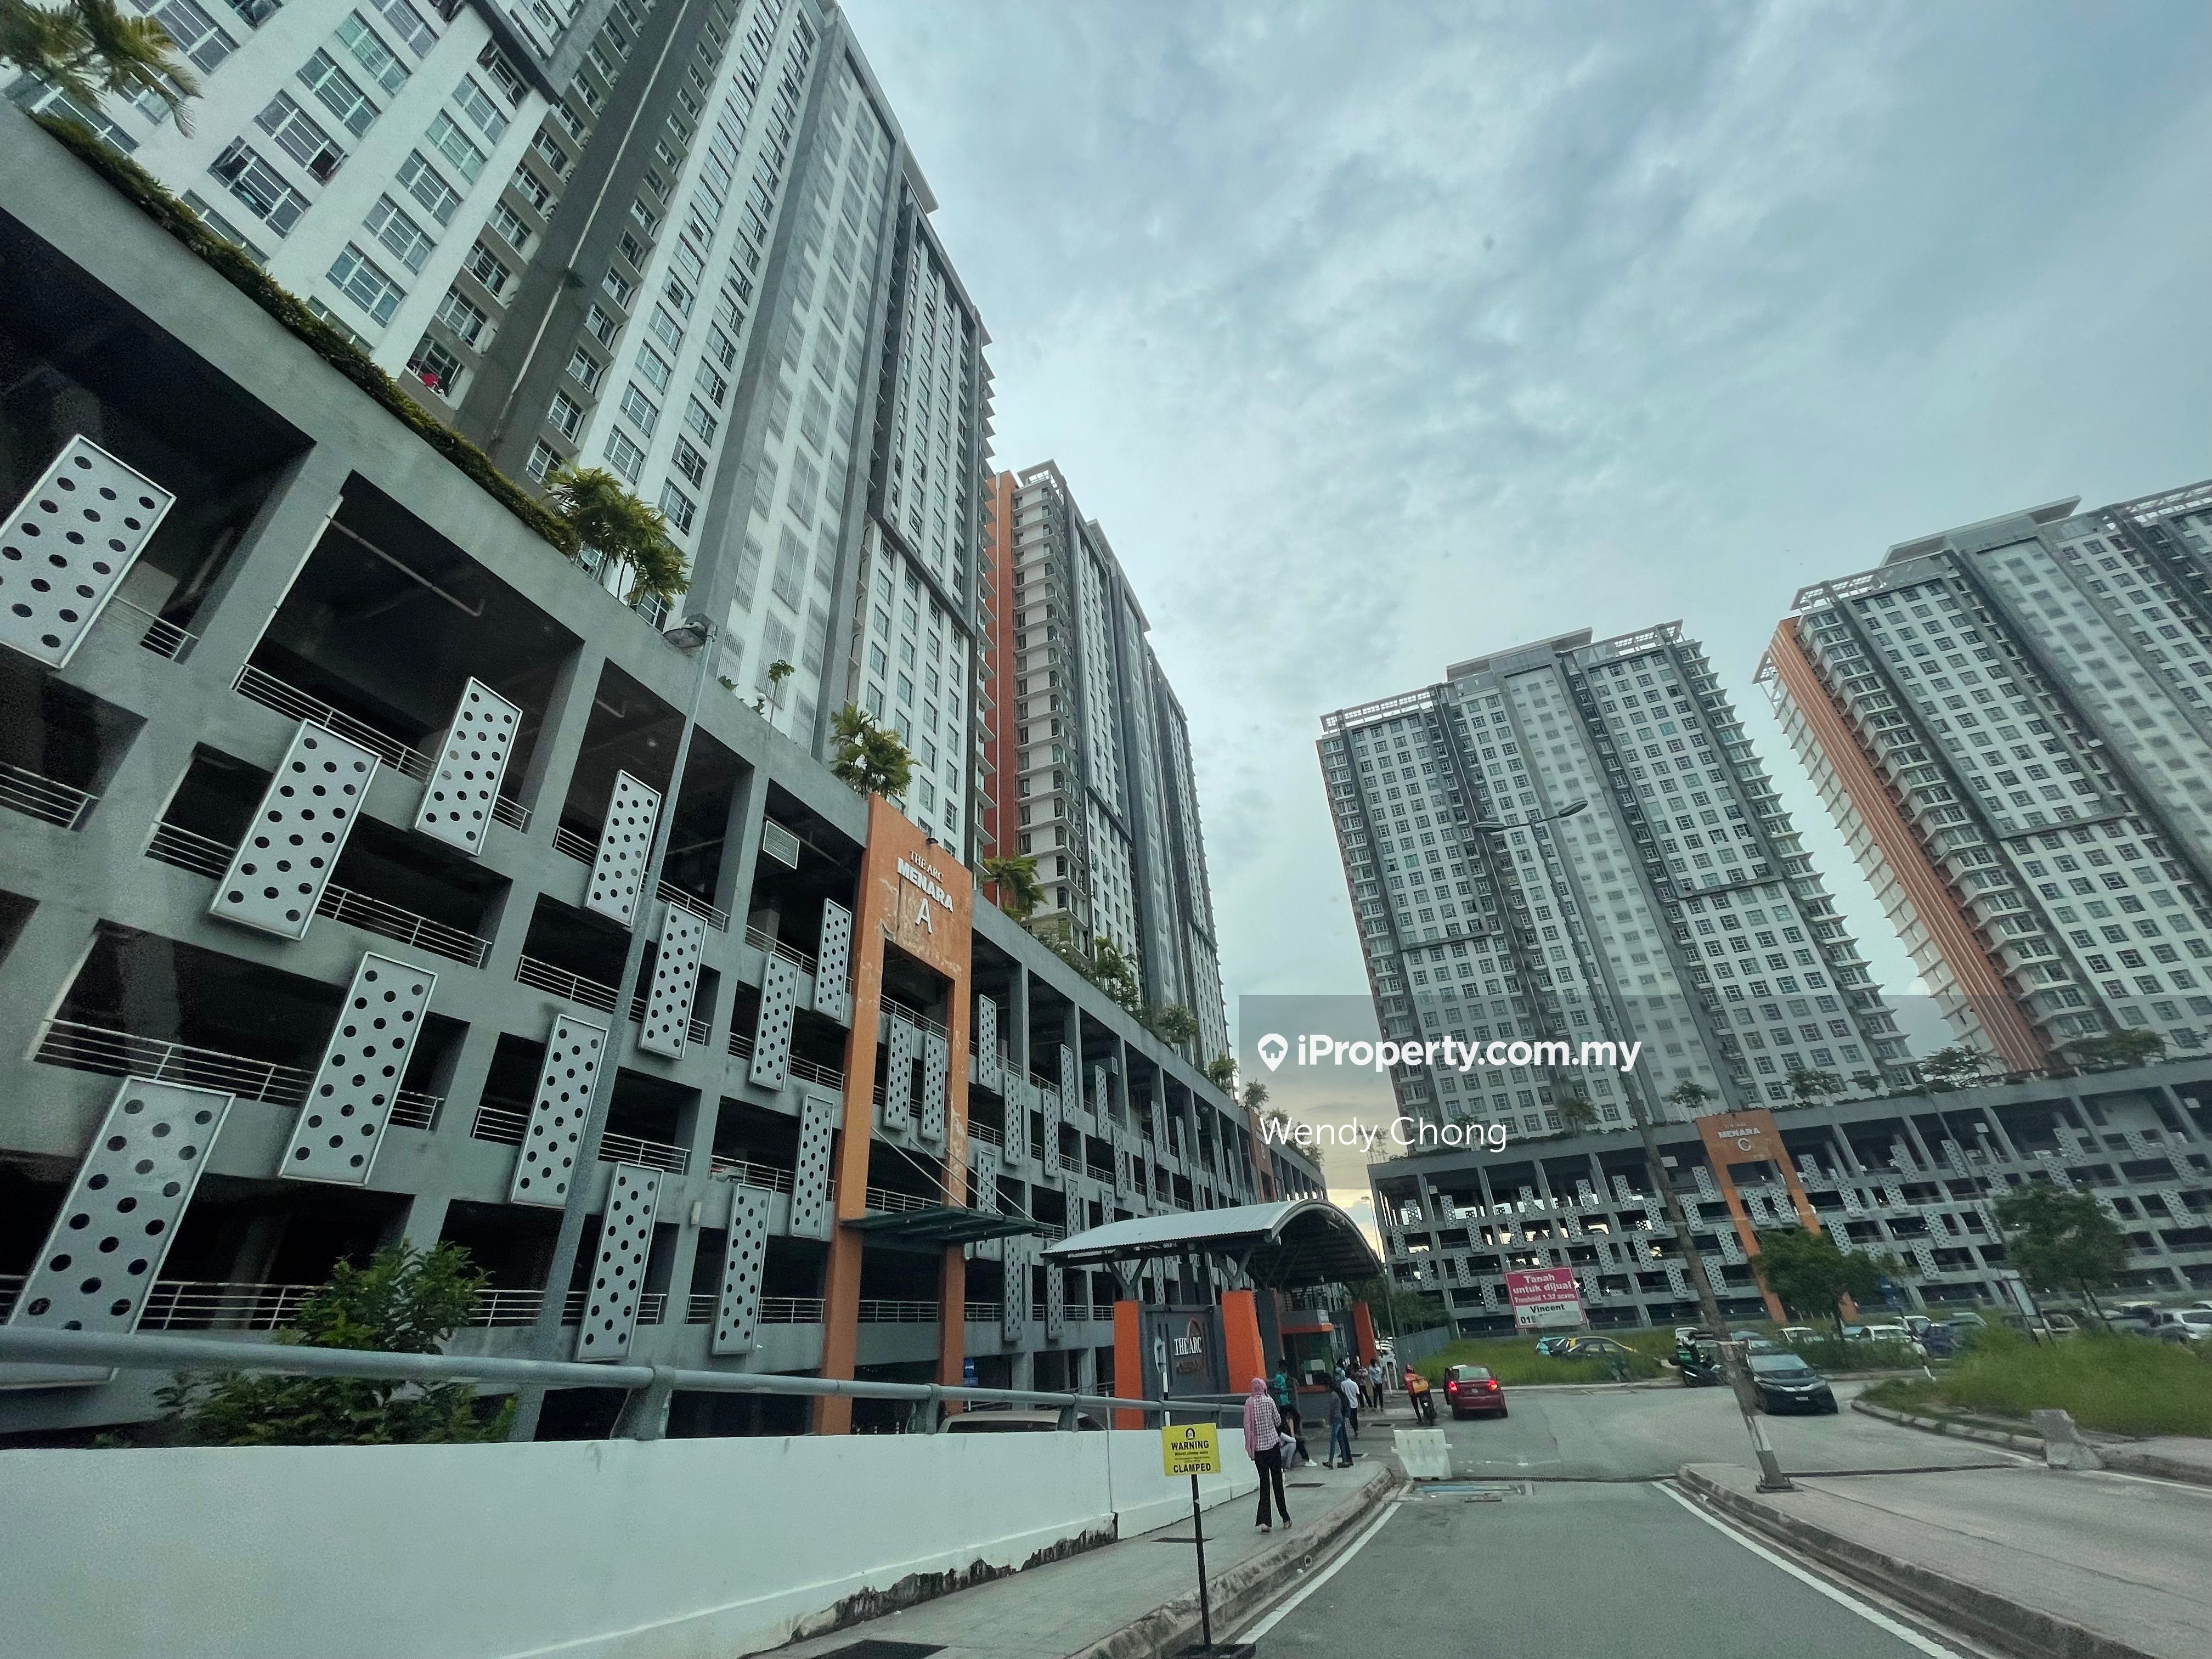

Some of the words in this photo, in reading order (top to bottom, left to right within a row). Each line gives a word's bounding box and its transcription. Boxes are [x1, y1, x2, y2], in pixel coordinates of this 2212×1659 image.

[910, 851, 926, 870] THE
[927, 864, 944, 883] ARC
[897, 857, 953, 913] MENARA
[915, 898, 932, 934] A
[1718, 1127, 1761, 1138] MENARA
[1737, 1137, 1752, 1152] C
[1523, 1273, 1555, 1283] Tanah
[1513, 1285, 1542, 1294] untuk
[1544, 1281, 1572, 1292] dijual
[1530, 1304, 1565, 1313] Vincent
[1174, 1338, 1189, 1356] THE
[1189, 1336, 1202, 1354] ARC
[1171, 1440, 1209, 1451] WARNING
[1173, 1463, 1211, 1473] CLAMPED
